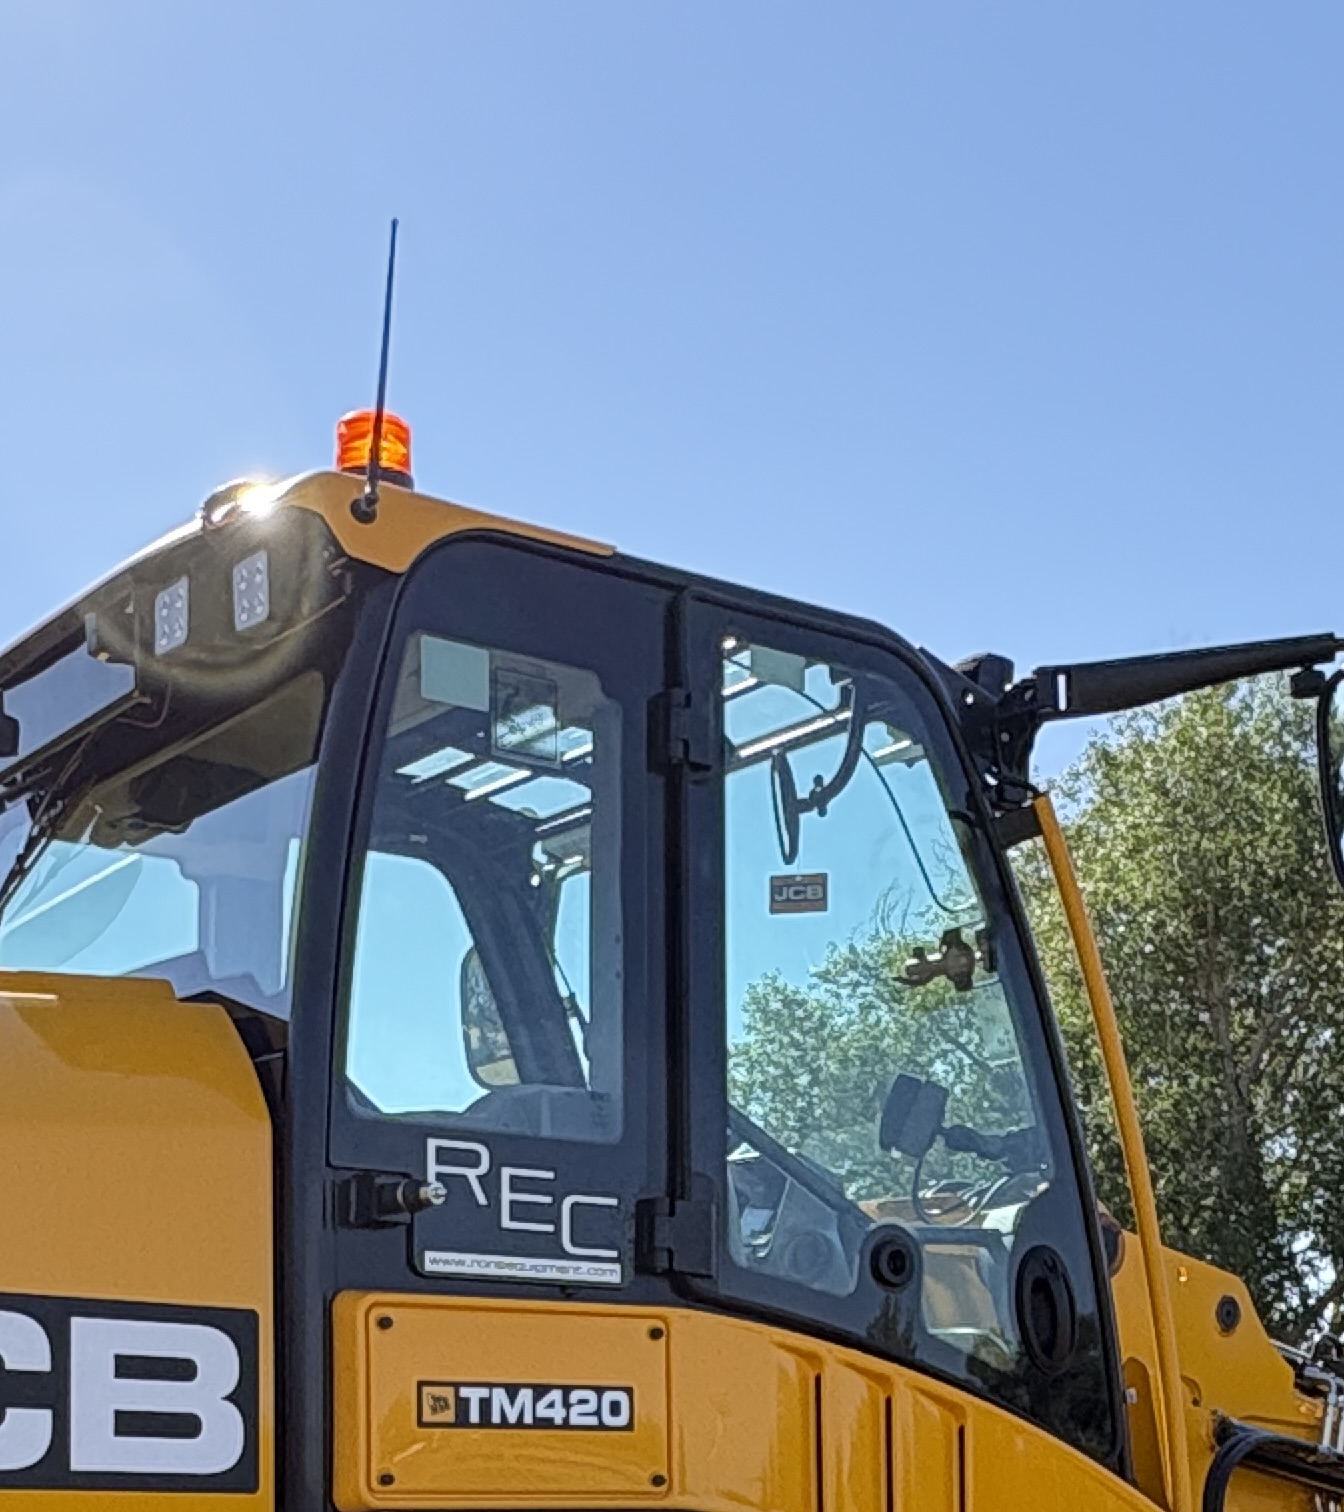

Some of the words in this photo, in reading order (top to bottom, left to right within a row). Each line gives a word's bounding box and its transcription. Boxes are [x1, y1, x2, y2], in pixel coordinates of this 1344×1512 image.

[774, 885, 823, 901] JCB
[426, 1137, 619, 1258] REC
[458, 1387, 630, 1427] TM420
